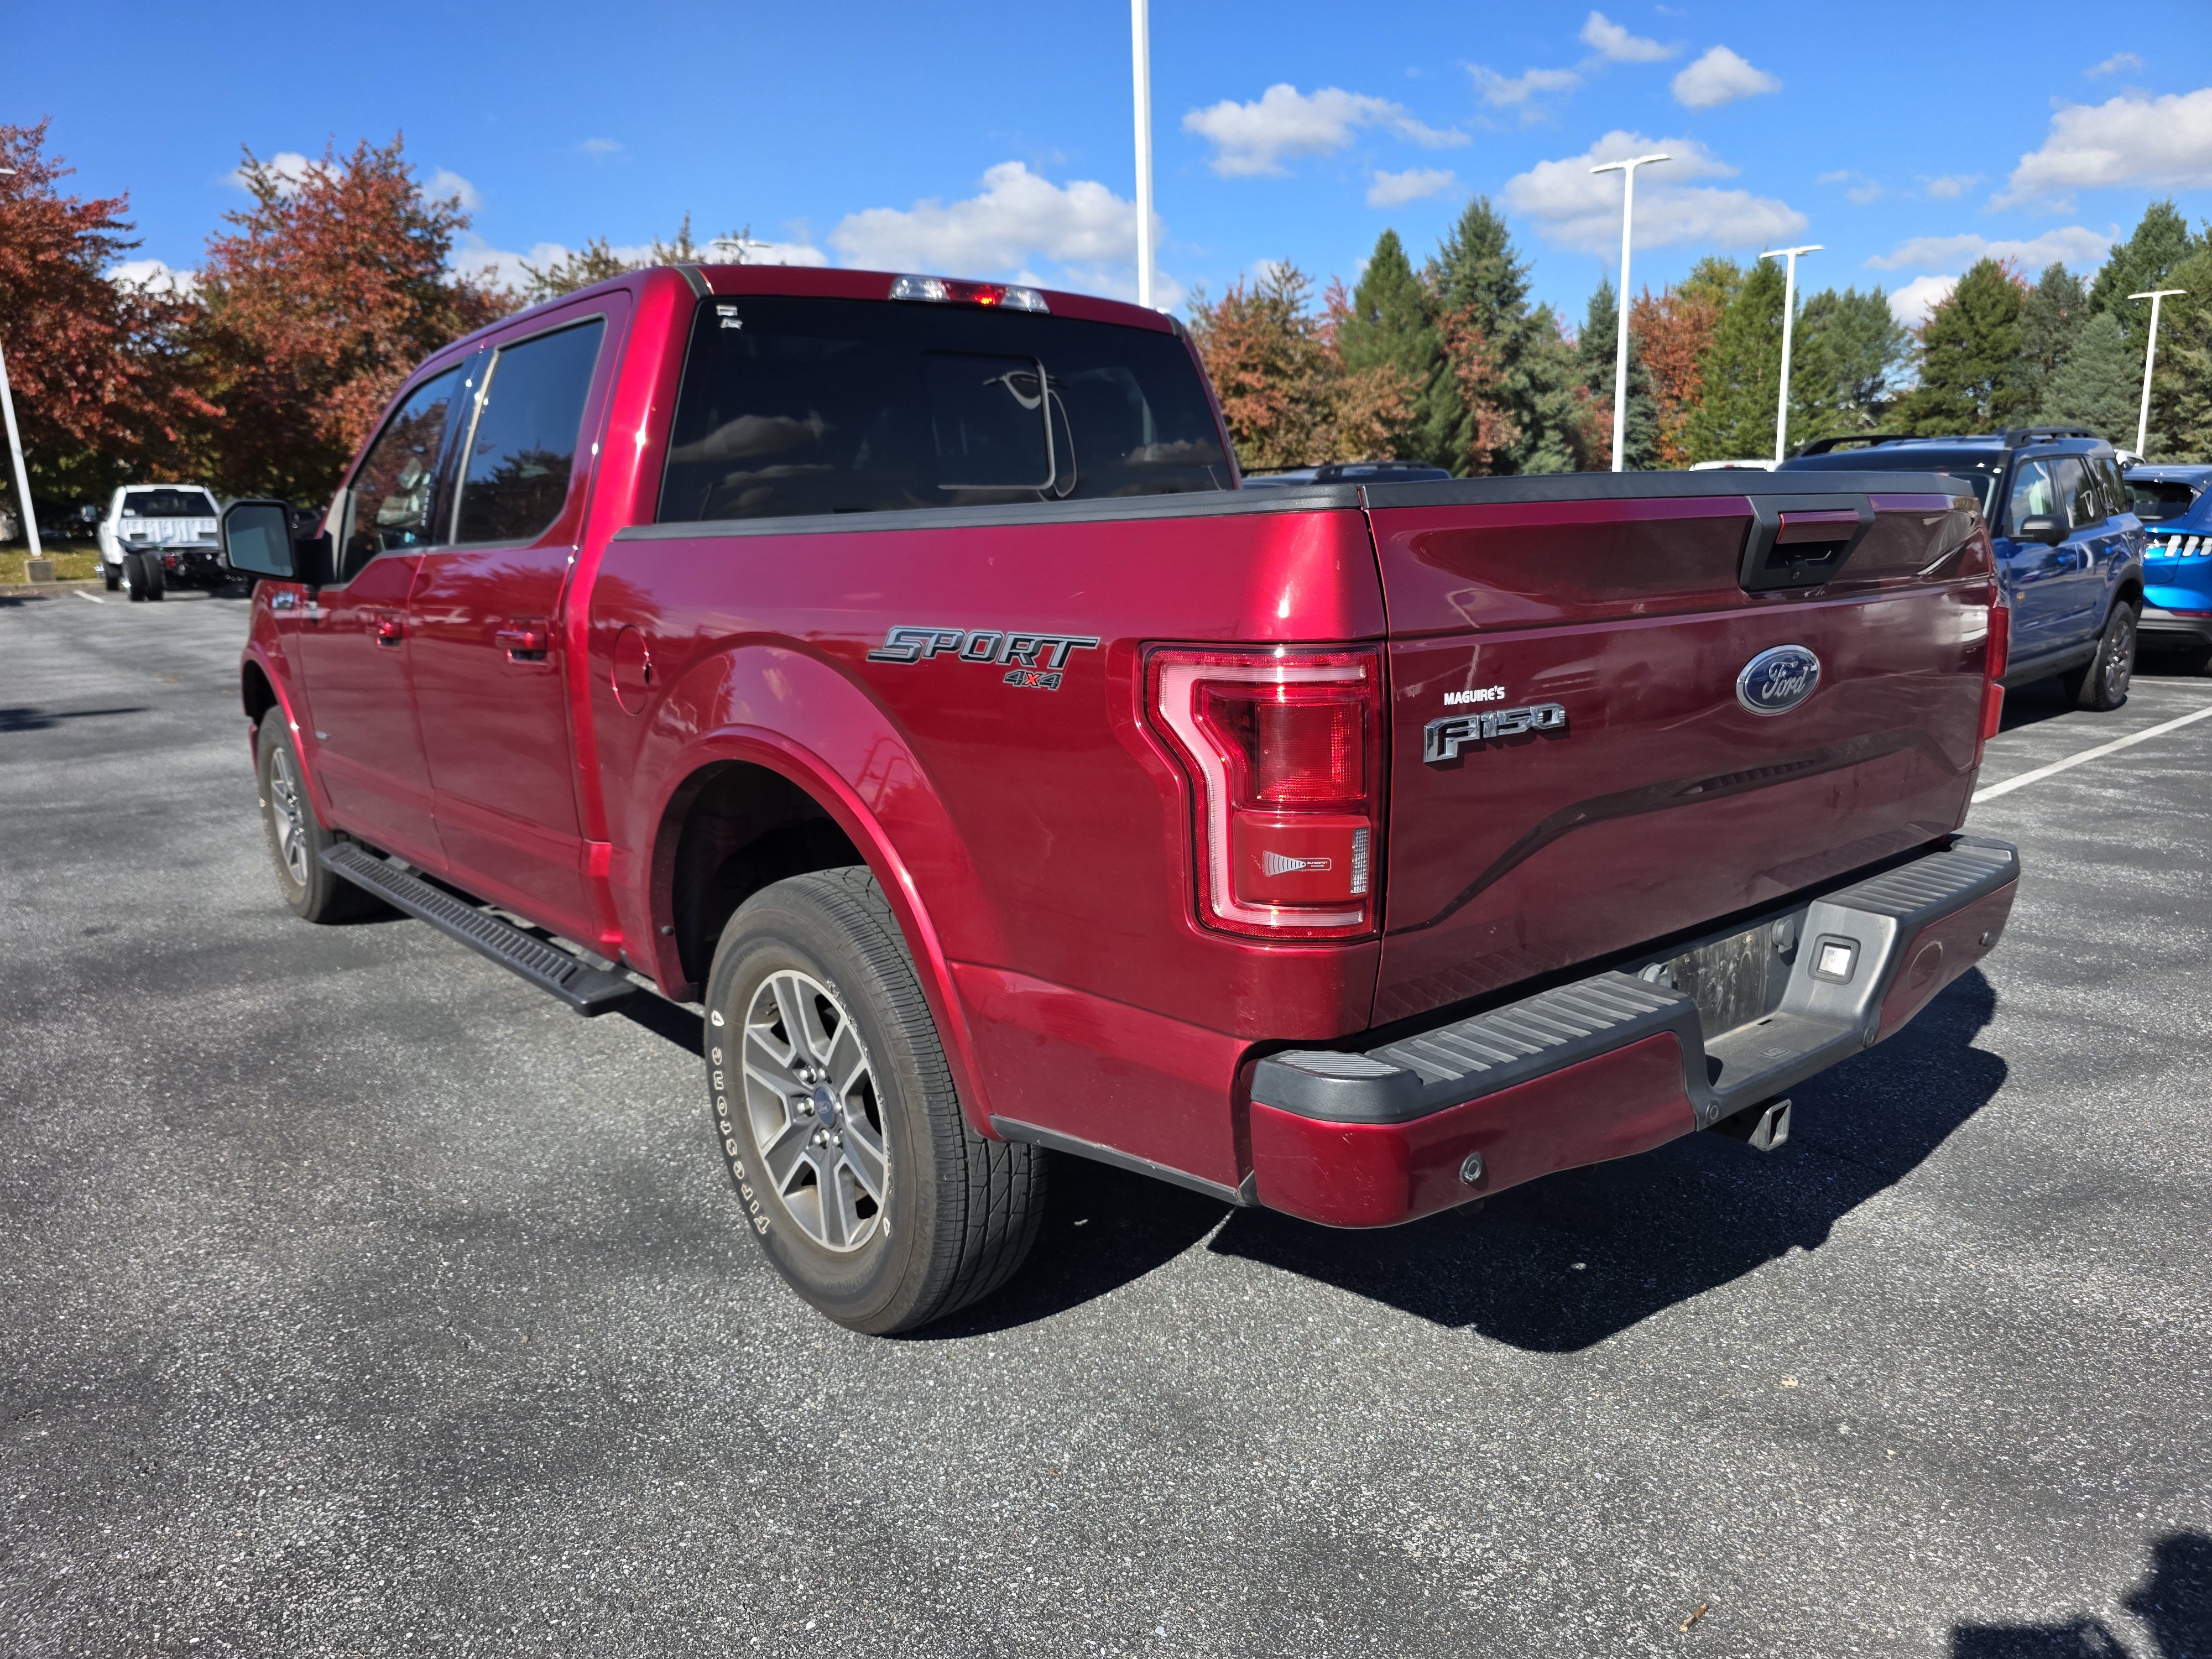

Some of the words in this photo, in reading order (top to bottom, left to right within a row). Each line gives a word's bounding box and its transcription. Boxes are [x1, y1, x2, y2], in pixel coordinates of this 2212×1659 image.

[866, 625, 1100, 669] SPORT
[1443, 685, 1506, 706] MAGUIRE'S
[1761, 660, 1809, 700] Ford
